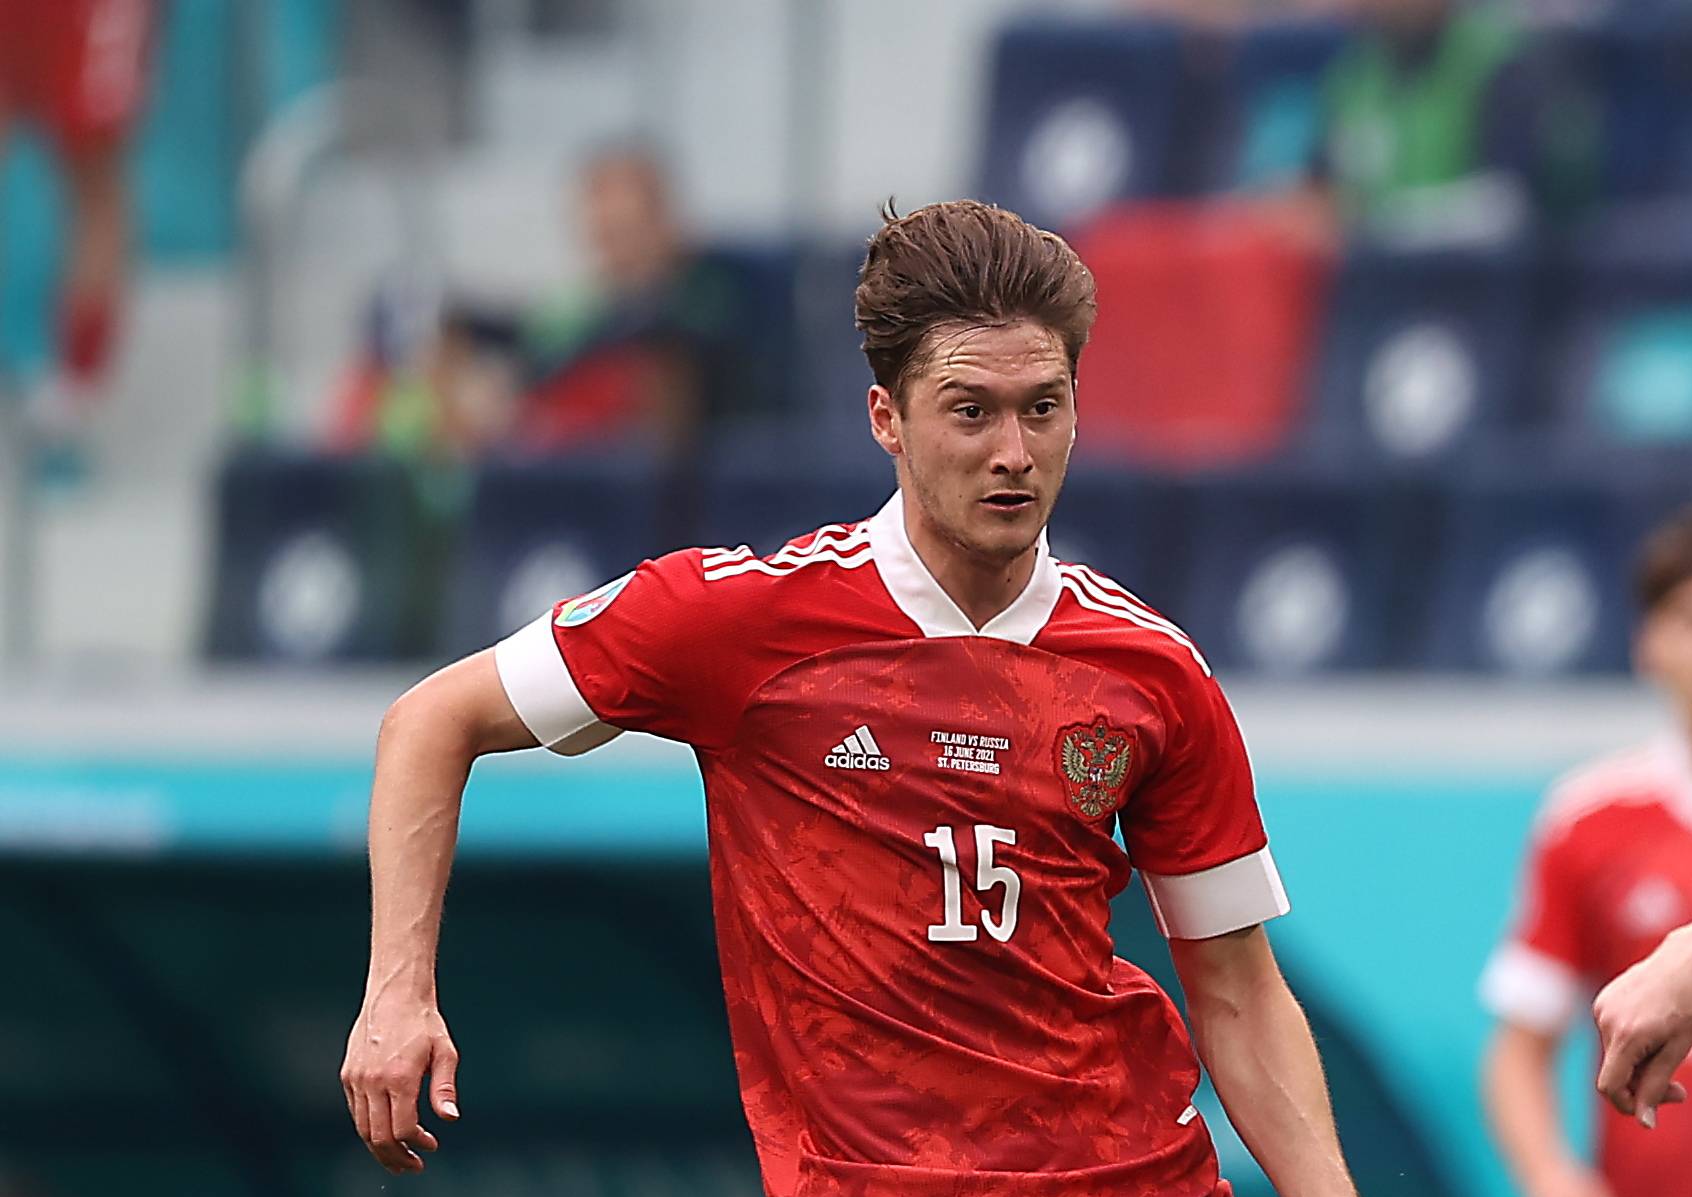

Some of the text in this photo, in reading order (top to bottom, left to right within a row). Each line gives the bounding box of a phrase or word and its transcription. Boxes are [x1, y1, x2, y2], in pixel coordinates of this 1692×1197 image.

[930, 731, 1009, 750] FINLAND VS RUSSIA
[824, 752, 891, 771] adidas
[943, 745, 995, 761] 16 JUNE 2021
[937, 756, 1000, 775] ST. PETERSBURG
[923, 824, 1021, 942] 15
